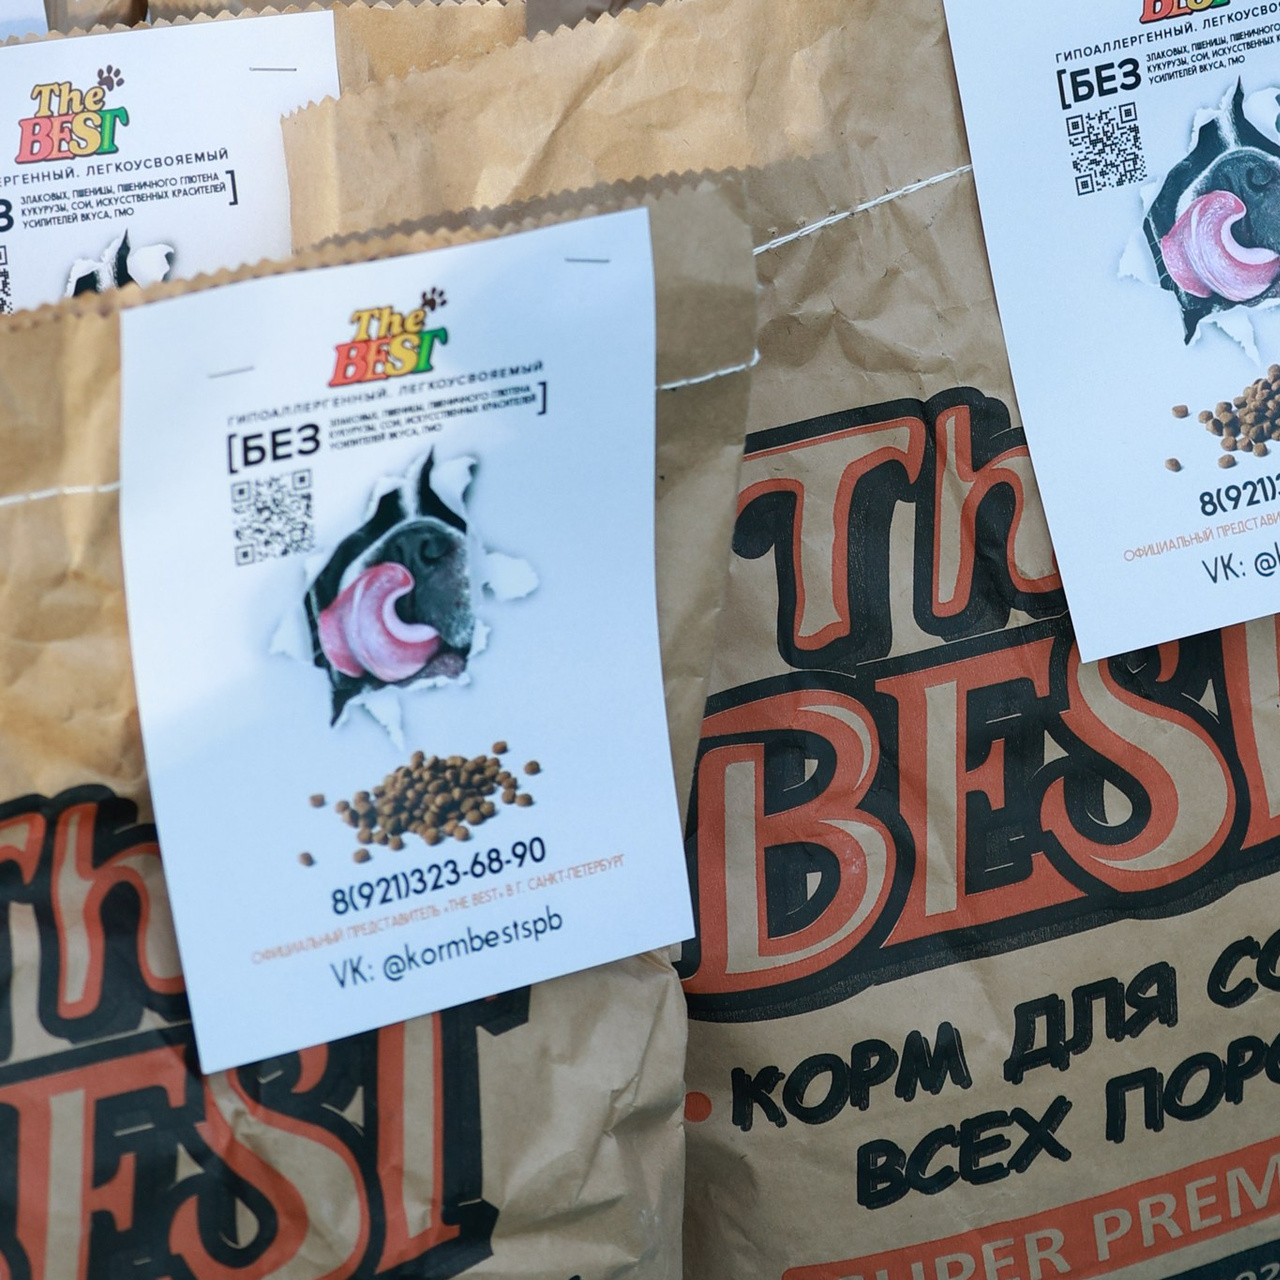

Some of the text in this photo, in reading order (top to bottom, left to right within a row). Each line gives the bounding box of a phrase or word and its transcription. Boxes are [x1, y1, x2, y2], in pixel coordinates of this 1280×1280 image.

[1055, 20, 1198, 63] ГИПОАЛЛЕРГЕННЫЙ.
[1211, 35, 1276, 59] ИСКУССТВЕННЫХ
[1148, 54, 1246, 85] УСИЛИТЕЛЕЙ ВКУСА, ГМО
[30, 80, 106, 118] The
[14, 106, 130, 164] BEST
[0, 147, 229, 188] РГЕННЫЙ. ЛЕГКОУСВОЯЕМЫЙ
[20, 172, 219, 206] ЗЛАКОВЫХ, ПШЕНИЦЫ, ПШЕНИЧНОГО ГЛЮТЕНА
[21, 202, 69, 218] КУКУРУЗЫ,
[71, 198, 94, 212] СОИ,
[95, 189, 170, 208] ИСКУССТВЕННЫХ
[171, 181, 227, 198] КРАСИТЕЛЕЙ
[22, 212, 79, 230] УСИЛИТЕЛЕЙ
[80, 209, 112, 224] ВКУСА,
[114, 207, 134, 219] ГМО
[350, 305, 428, 342] The
[327, 327, 449, 387] BEST
[731, 387, 1070, 671] Th
[1124, 526, 1213, 562] ОФИЦИАЛЬНЫЙ
[1202, 553, 1246, 584] VK:
[332, 835, 547, 916] 8(921)323-68-90
[330, 905, 564, 989] VK: @kormbestspb
[730, 1021, 973, 1132] КОРМ
[1003, 960, 1179, 1083] ДЛЯ
[856, 1095, 1071, 1209] ВСЕХ
